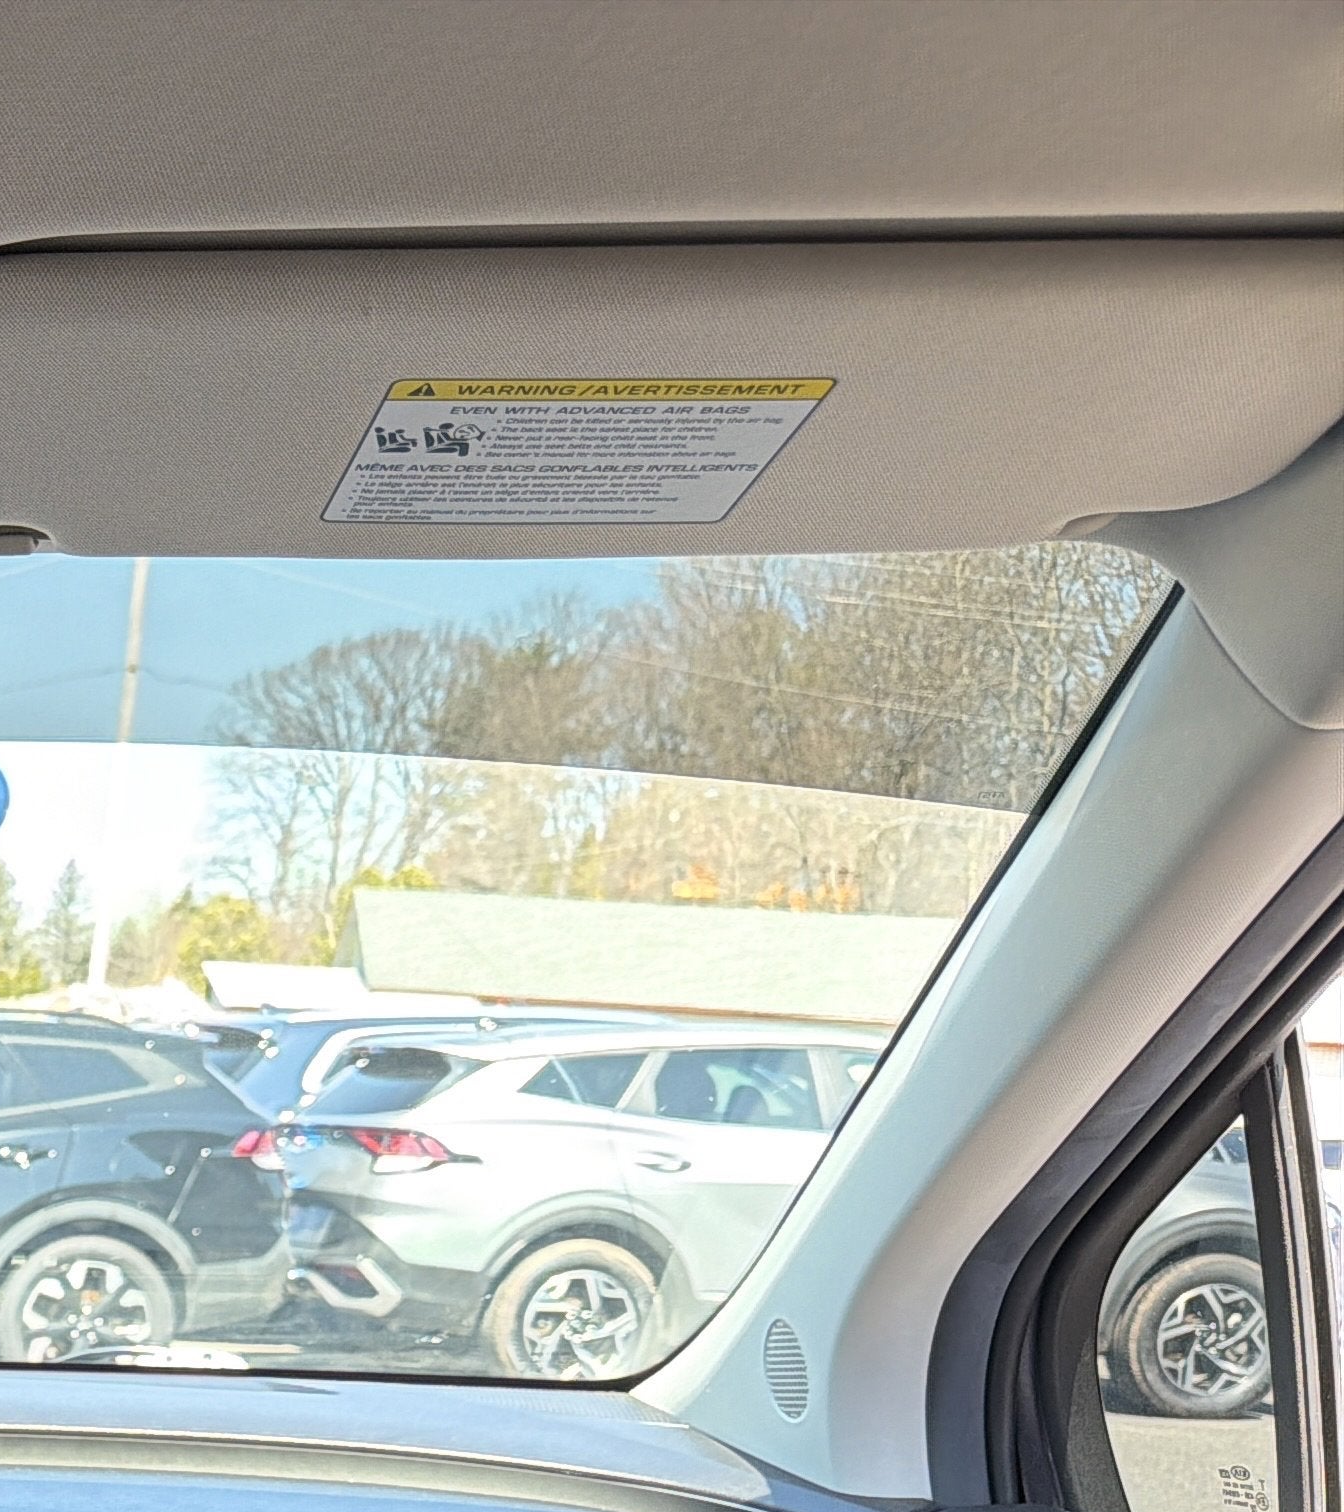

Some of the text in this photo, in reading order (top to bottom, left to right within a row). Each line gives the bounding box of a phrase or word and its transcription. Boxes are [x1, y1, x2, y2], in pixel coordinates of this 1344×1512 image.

[450, 406, 751, 415] EVEN WITH ADVANCED AIR BAGS
[355, 462, 759, 472] MÊME AVEC DES SACS GONFLABLES INTELLIGENTS
